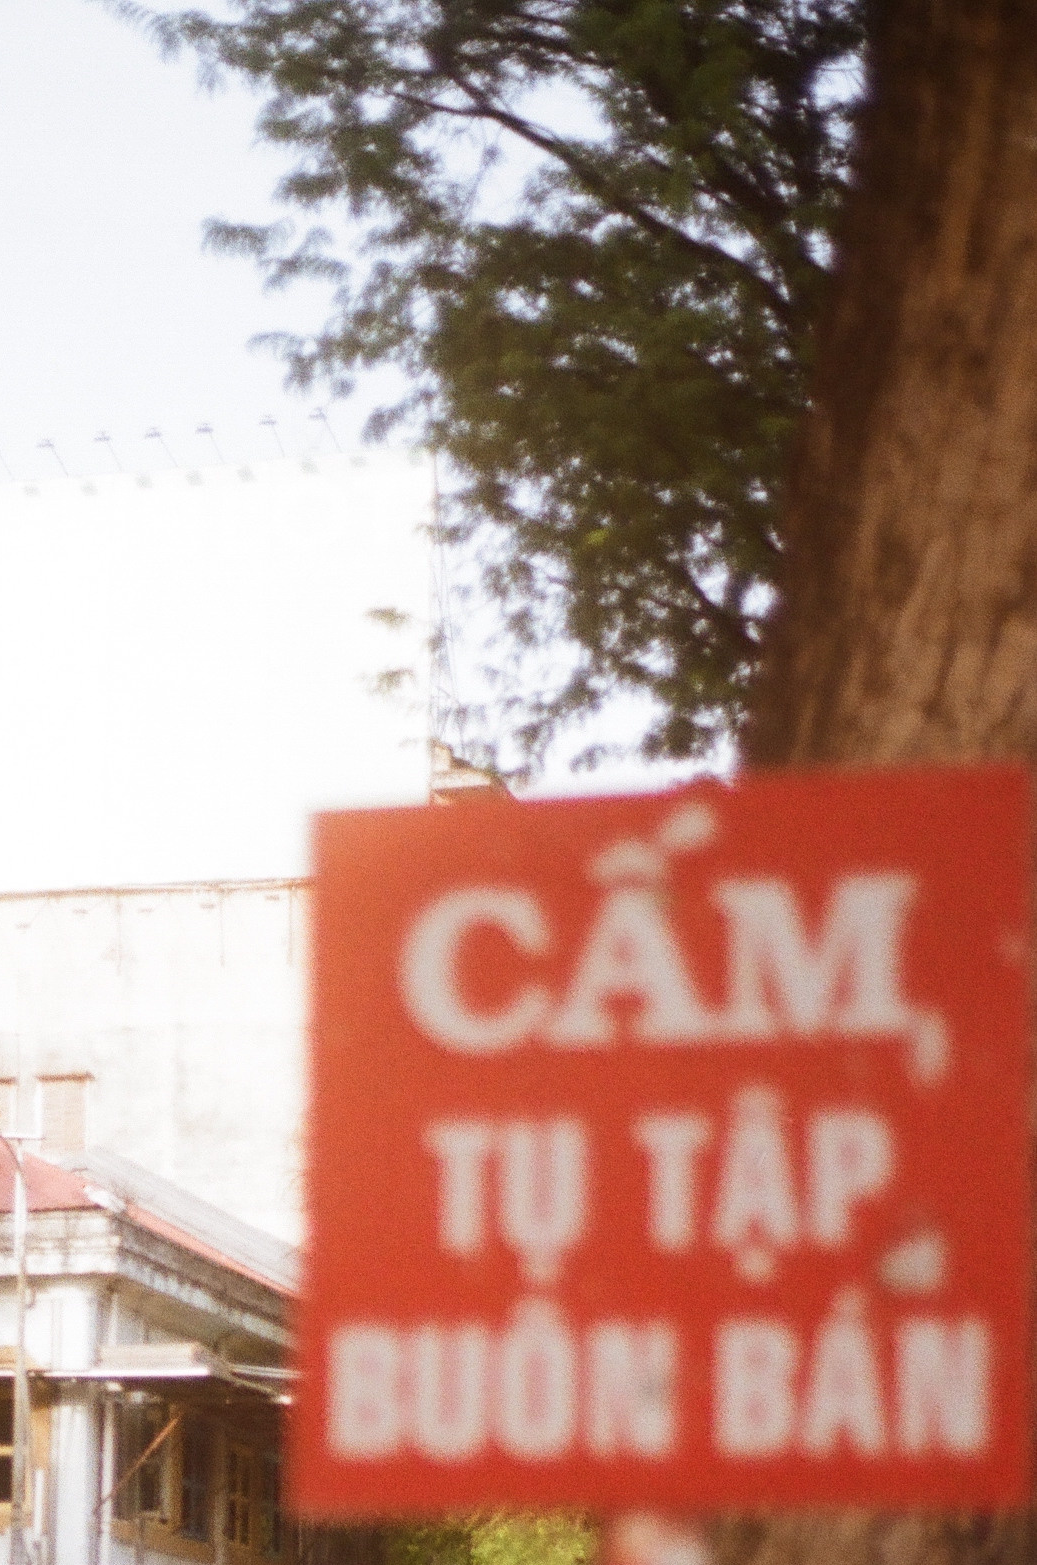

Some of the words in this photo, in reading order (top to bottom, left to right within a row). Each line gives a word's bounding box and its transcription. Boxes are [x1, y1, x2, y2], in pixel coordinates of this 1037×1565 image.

[425, 1112, 590, 1284] TỤ
[632, 1084, 896, 1286] TẬP
[326, 1290, 678, 1460] BUÔN
[712, 1228, 992, 1460] BÁN
